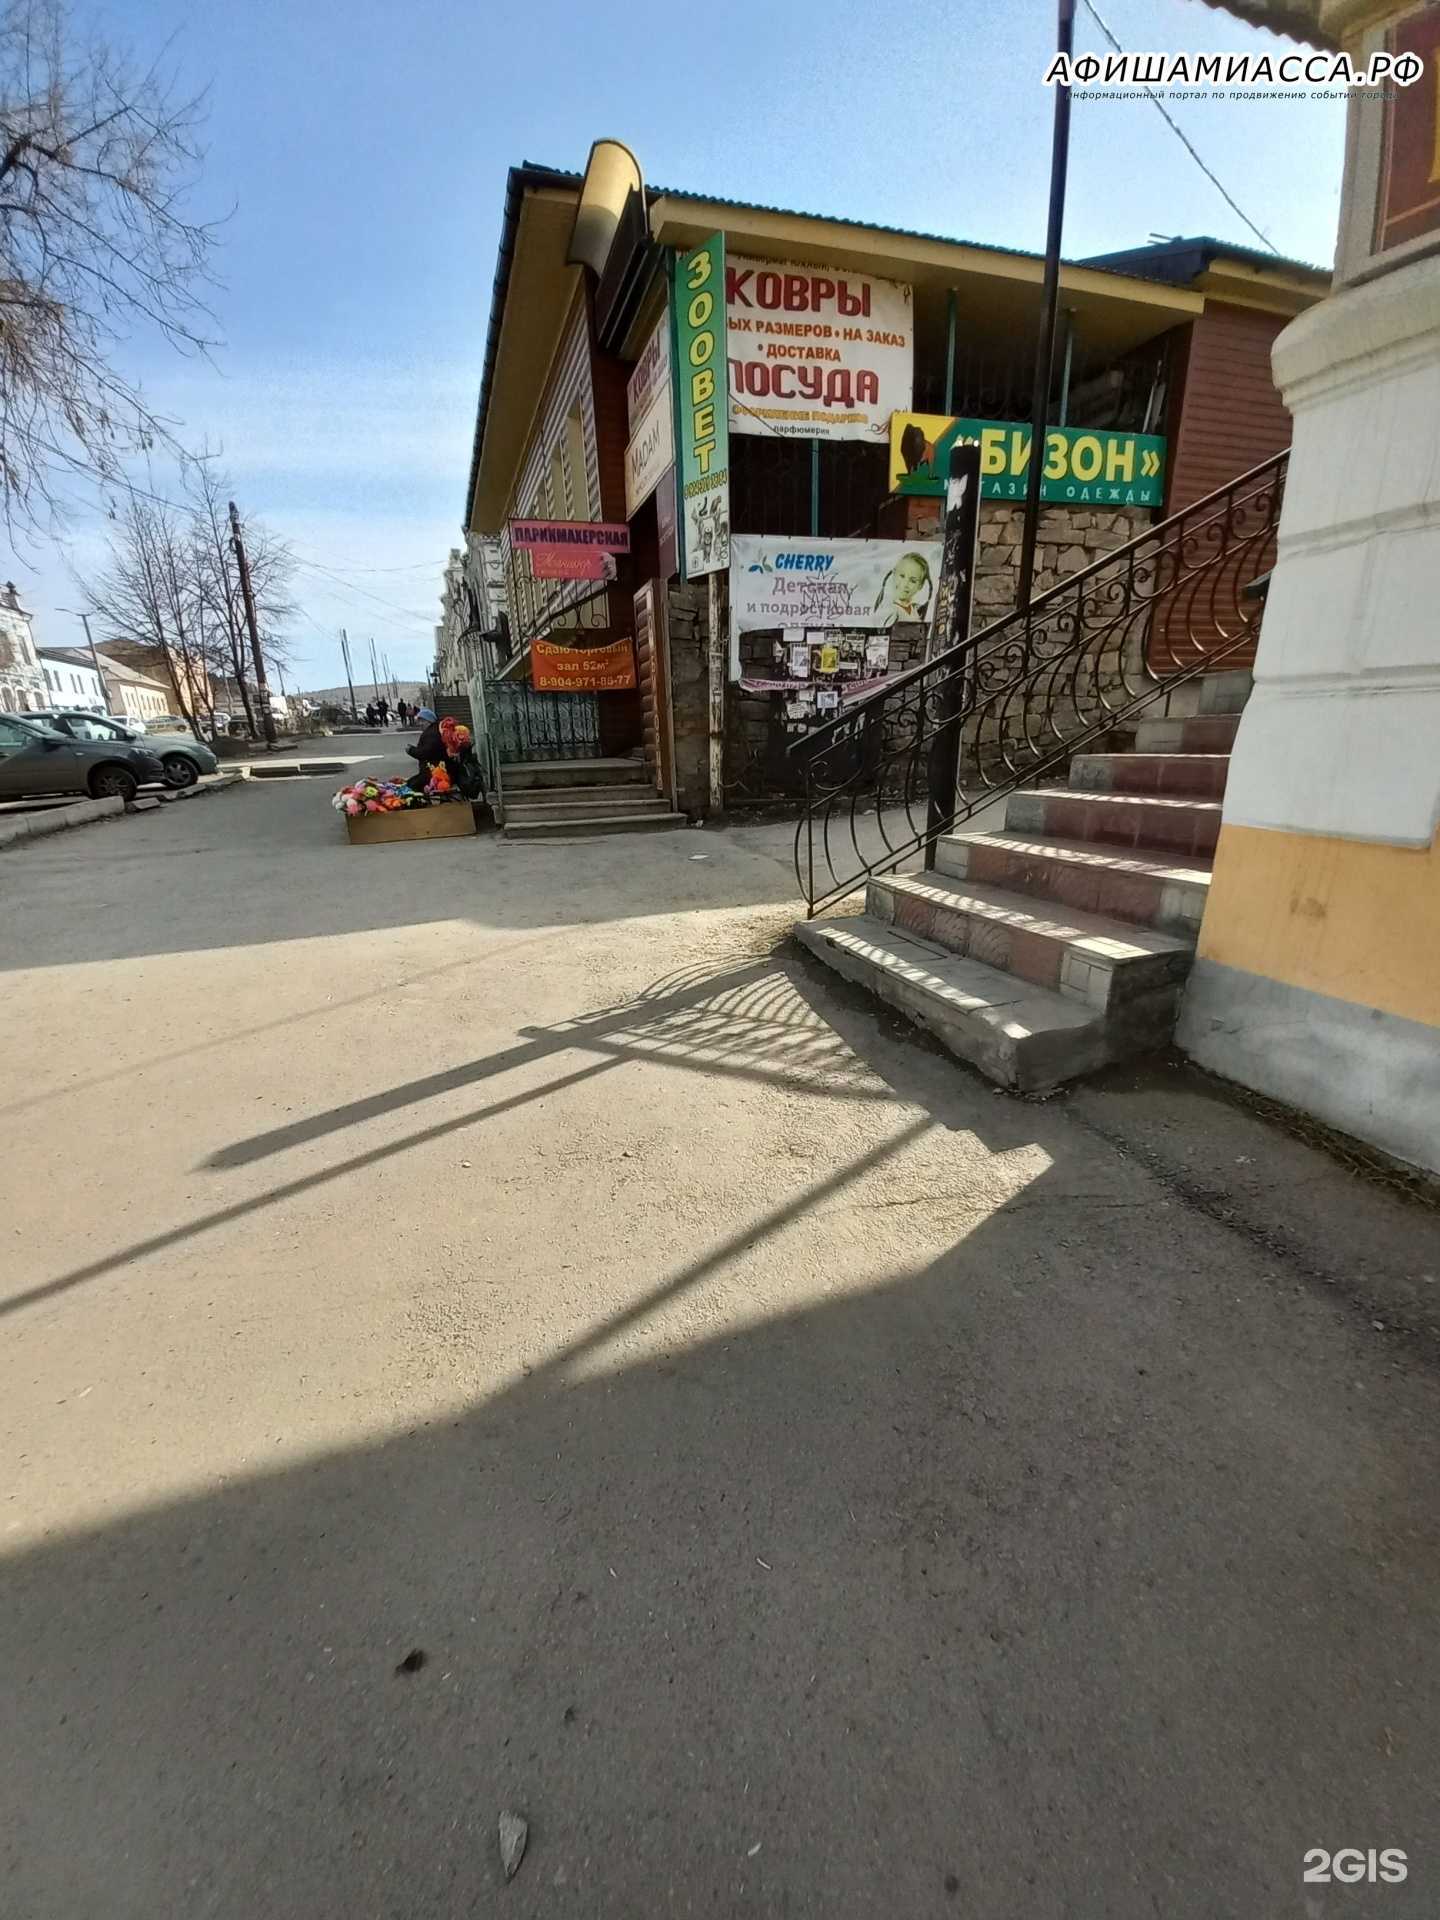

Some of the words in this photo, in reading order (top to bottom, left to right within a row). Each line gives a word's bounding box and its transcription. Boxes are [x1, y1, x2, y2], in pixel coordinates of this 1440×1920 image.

[726, 267, 871, 318] КОВРЫ
[727, 317, 752, 332] ЫХ
[755, 320, 833, 339] РАЗМЕРОВ
[843, 327, 863, 341] НА
[866, 330, 906, 348] ЗАКАЗ
[686, 249, 717, 475] ЗООВЕТ
[766, 343, 841, 362] ДОСТАВКА
[728, 358, 879, 409] ПОСУДА
[1066, 485, 1151, 502] ОДЕЖДЫ
[514, 526, 629, 547] ПАРИКМАХЕРСКАЯ
[774, 553, 835, 572] CHERRY
[746, 602, 757, 613] и
[760, 602, 872, 618] подростковая
[556, 662, 580, 671] зал
